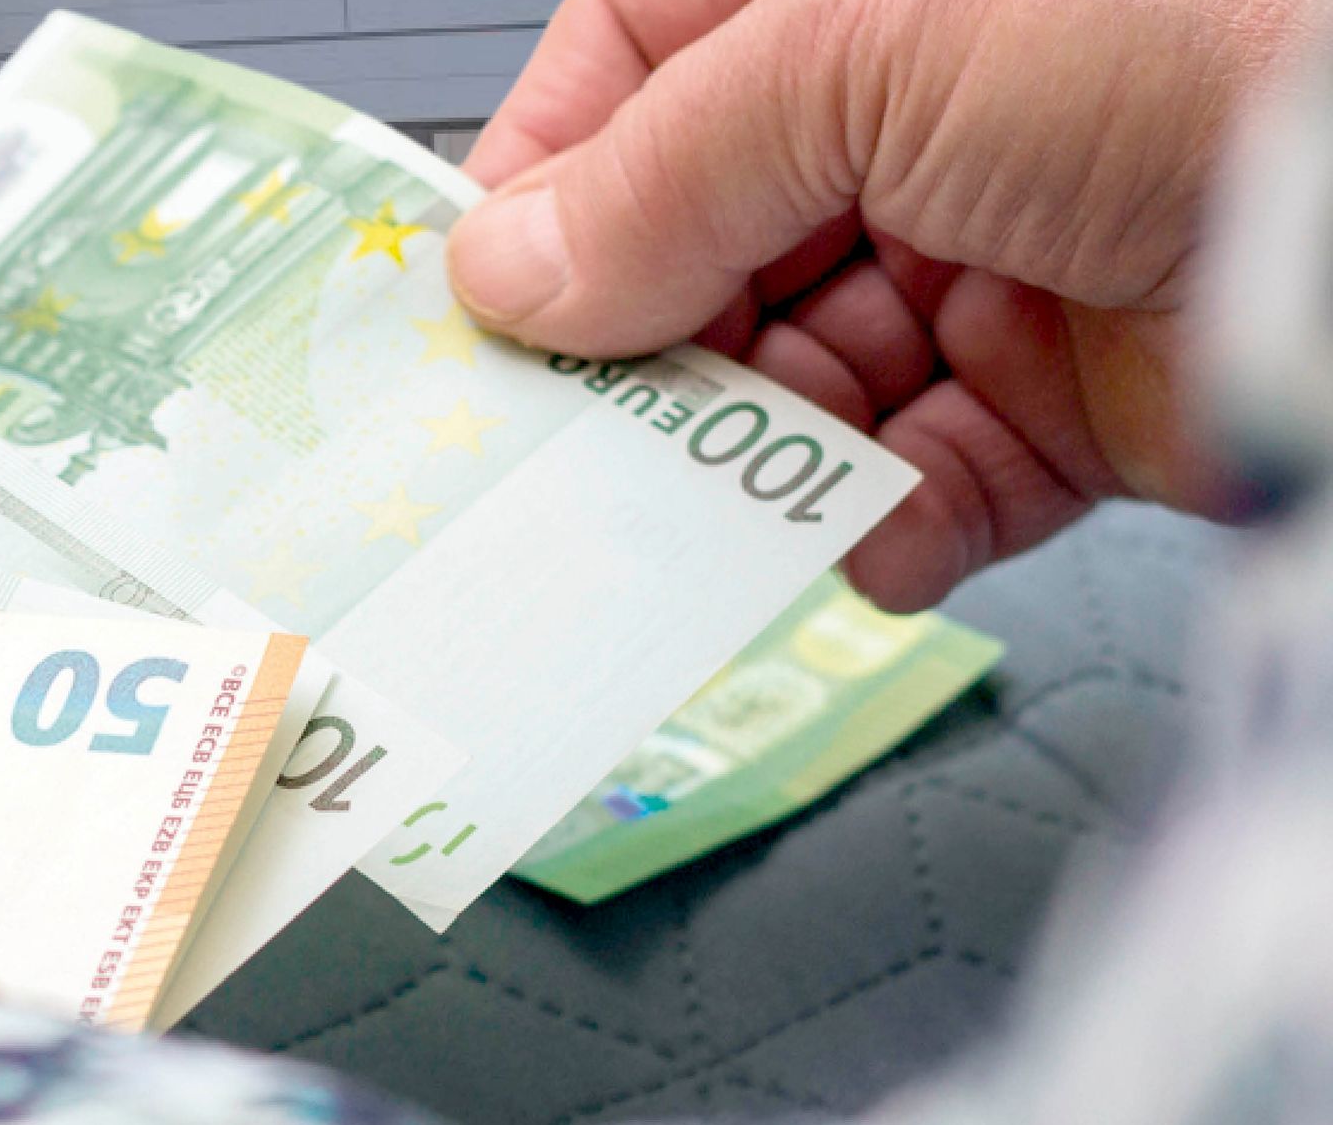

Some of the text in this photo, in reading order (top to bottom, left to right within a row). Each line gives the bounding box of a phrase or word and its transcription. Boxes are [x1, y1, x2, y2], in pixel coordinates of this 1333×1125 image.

[687, 401, 854, 523] 100
[10, 648, 190, 756] 50
[277, 715, 388, 812] 10
